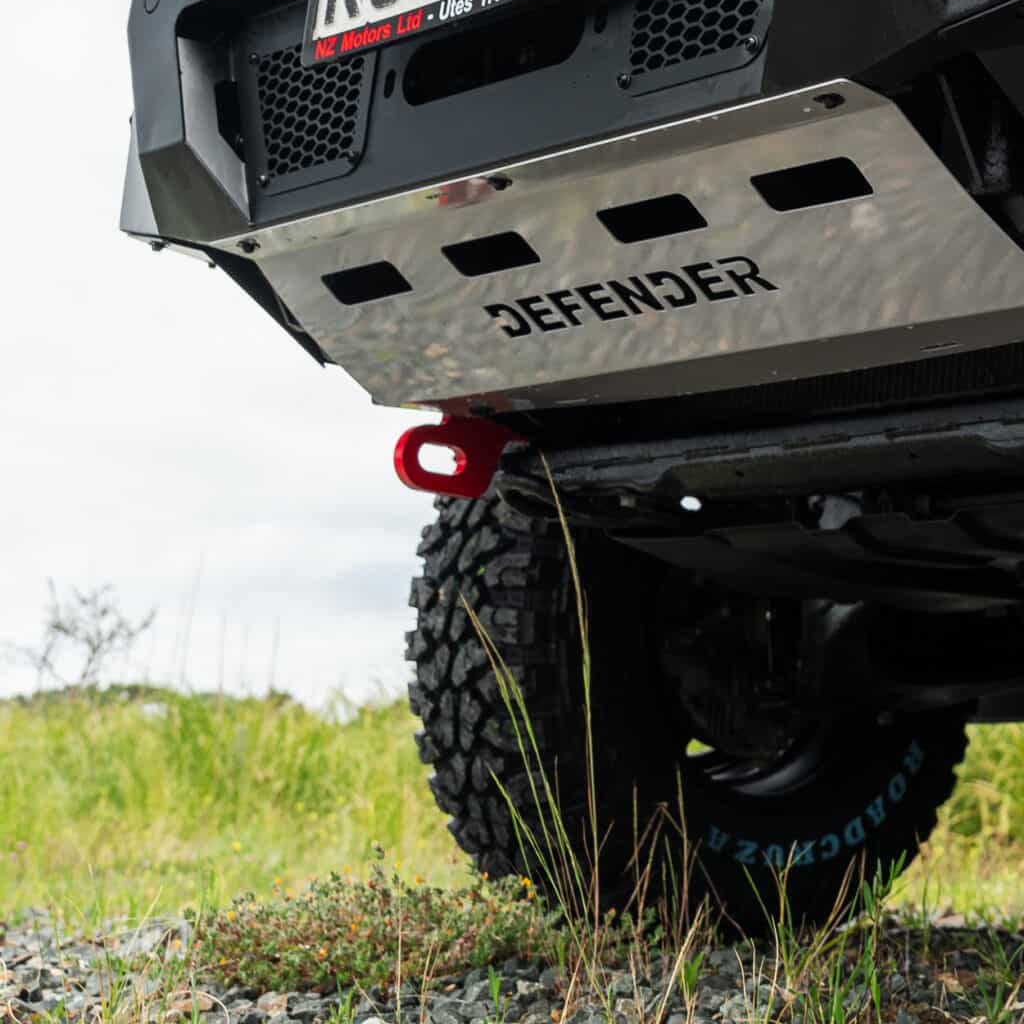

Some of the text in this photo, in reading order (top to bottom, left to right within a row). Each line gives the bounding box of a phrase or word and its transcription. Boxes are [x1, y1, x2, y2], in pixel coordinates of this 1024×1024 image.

[314, 34, 336, 60] NZ
[340, 22, 392, 52] Motors
[396, 8, 424, 34] Ltd
[483, 255, 779, 338] DEFENDER
[707, 739, 925, 867] ROADCRUZA
